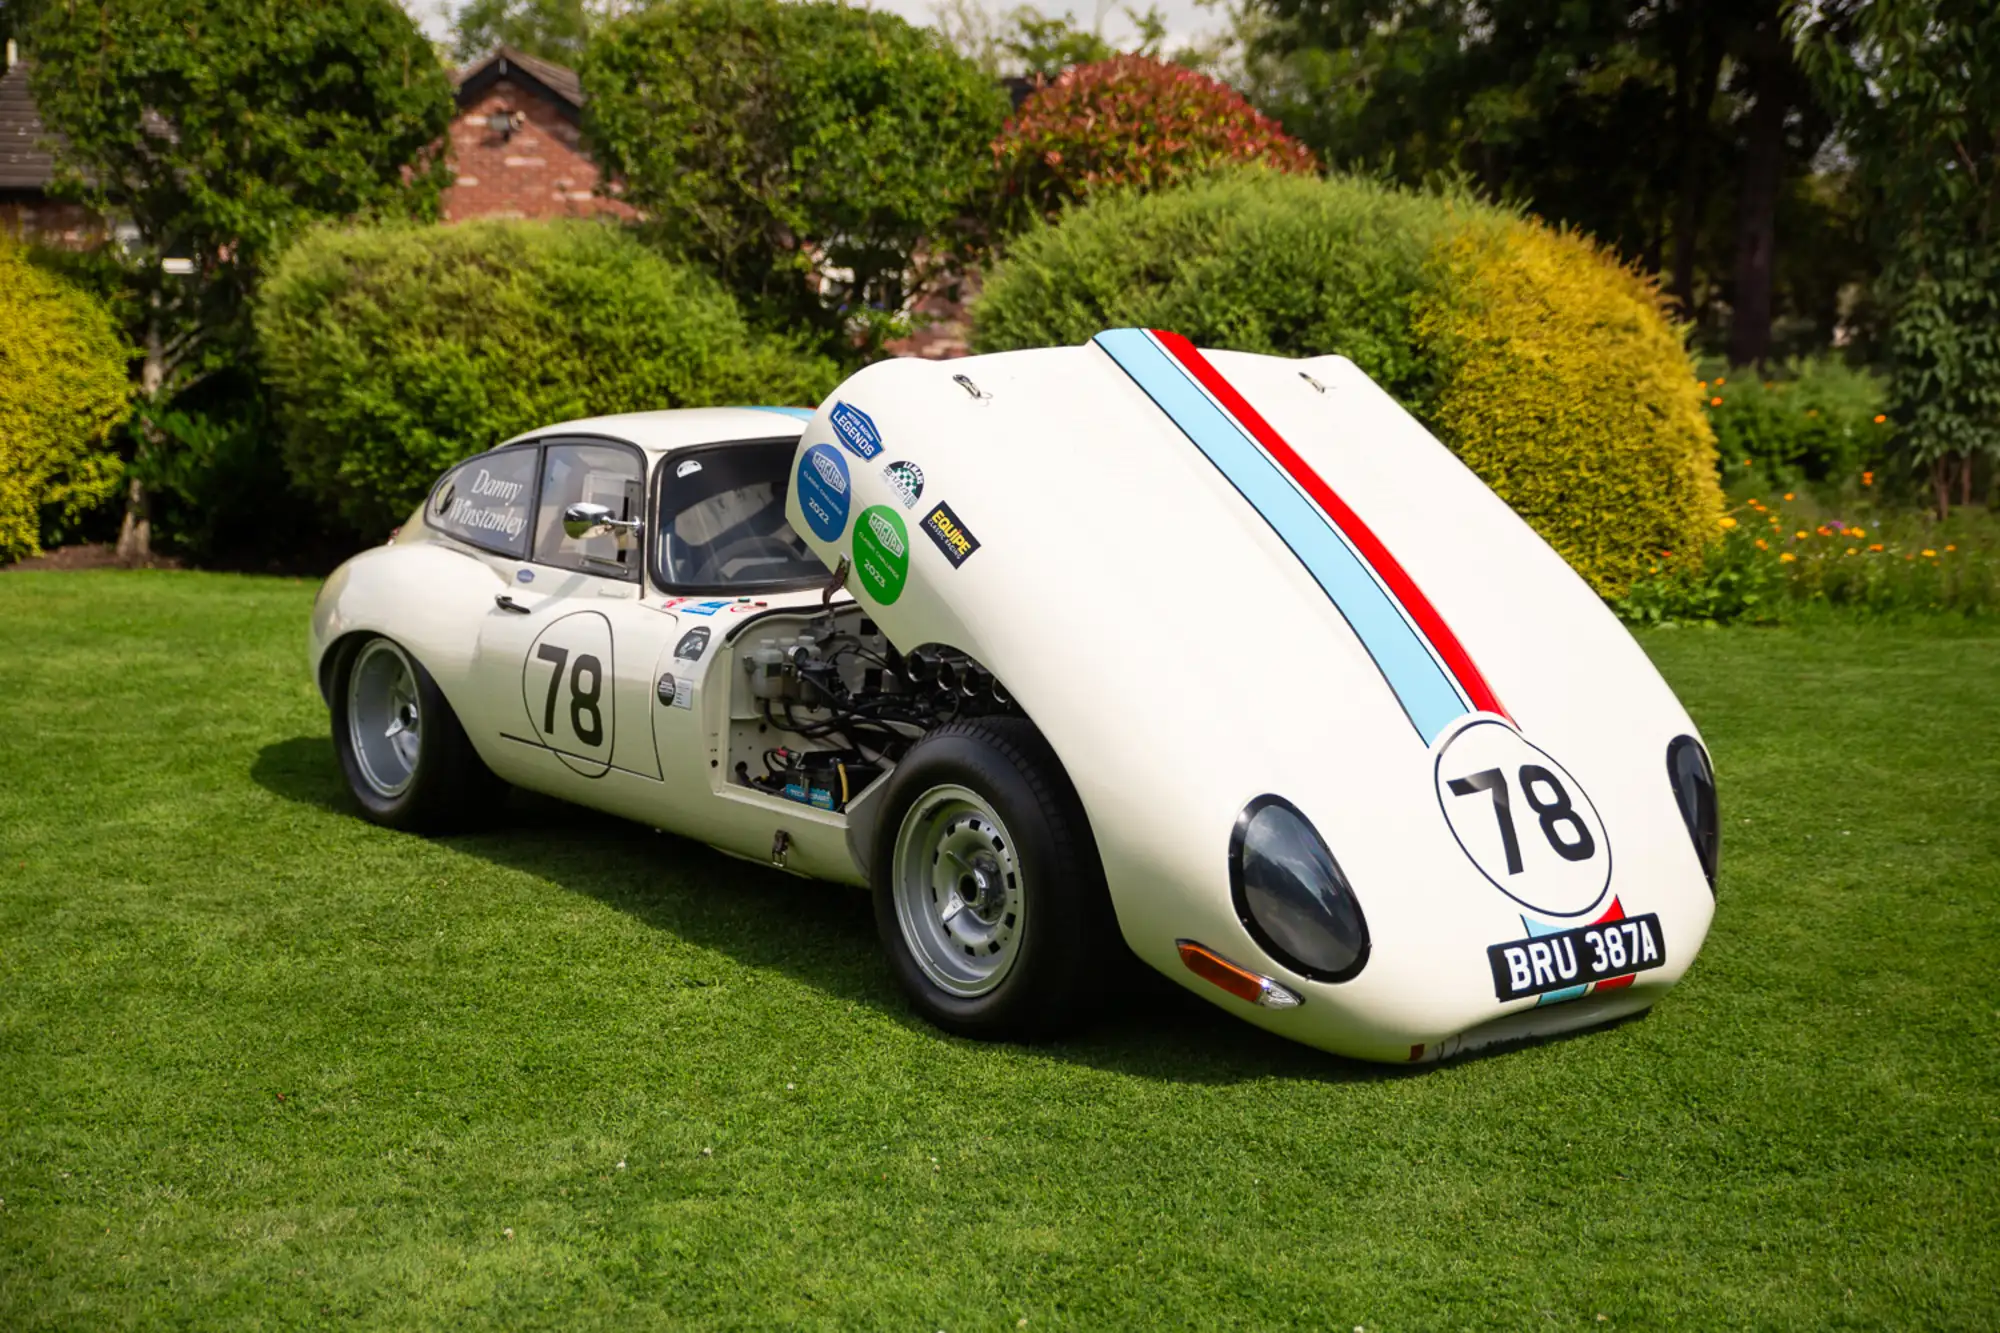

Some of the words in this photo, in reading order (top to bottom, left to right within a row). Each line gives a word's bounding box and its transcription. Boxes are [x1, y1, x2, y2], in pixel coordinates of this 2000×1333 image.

[832, 410, 875, 457] LEGENDS
[471, 469, 523, 506] Danny
[814, 453, 845, 492] JAGUAR
[449, 497, 528, 541] Winstanley
[808, 497, 830, 526] 2022
[931, 509, 972, 556] EQUIPE
[869, 513, 904, 557] JAGUAR
[927, 519, 946, 540] CLASSIC
[944, 539, 962, 560] RACING
[863, 559, 886, 588] 2023
[537, 642, 603, 747] 78
[1446, 764, 1596, 876] 78
[1503, 936, 1578, 992] BRU
[1584, 920, 1659, 974] 387A
